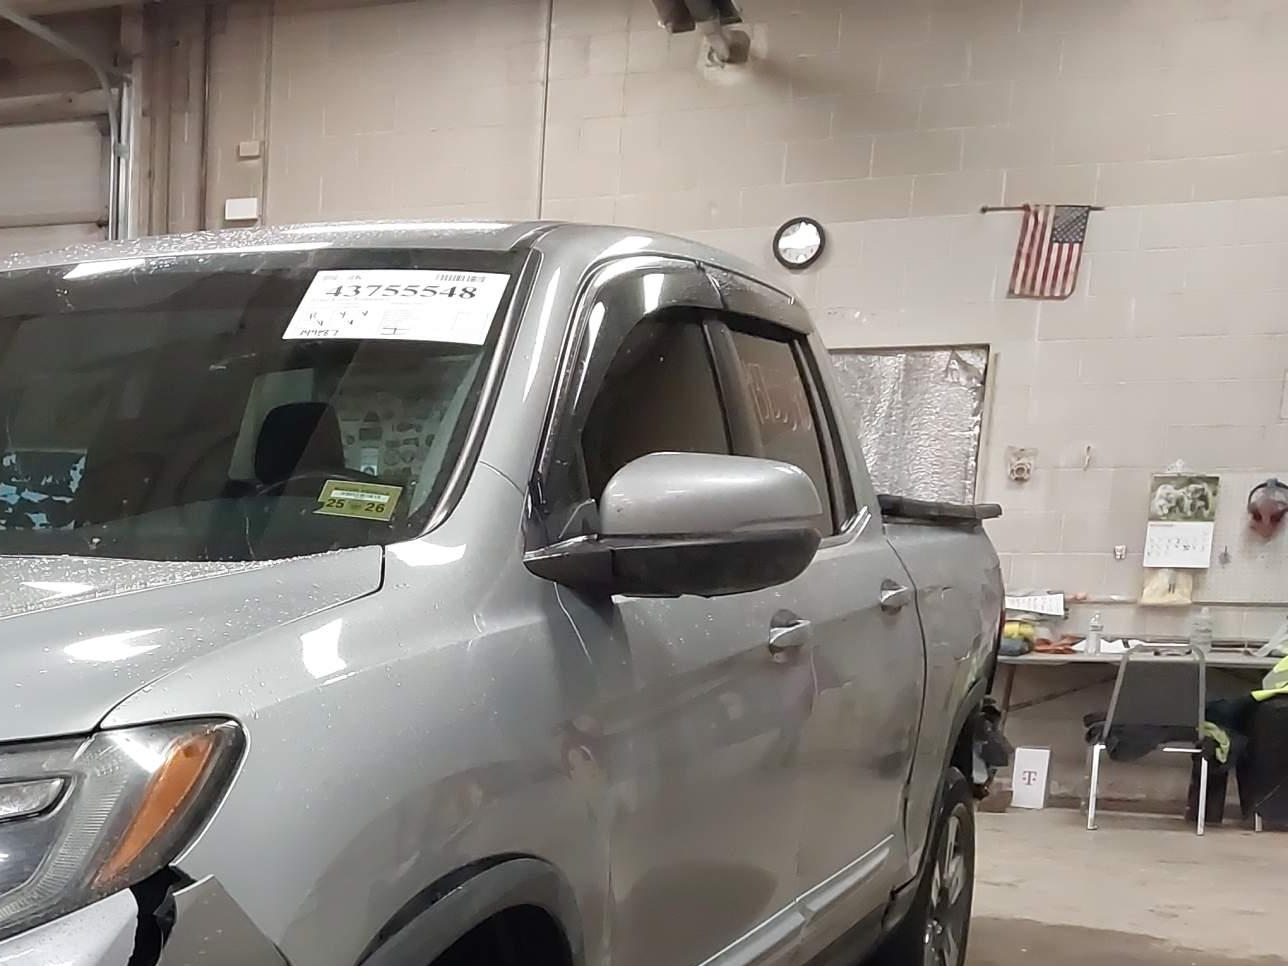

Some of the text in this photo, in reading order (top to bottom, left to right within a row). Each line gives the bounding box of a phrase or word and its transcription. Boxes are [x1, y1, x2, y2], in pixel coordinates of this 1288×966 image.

[325, 284, 477, 299] 43755548
[326, 498, 385, 513] 25 26
